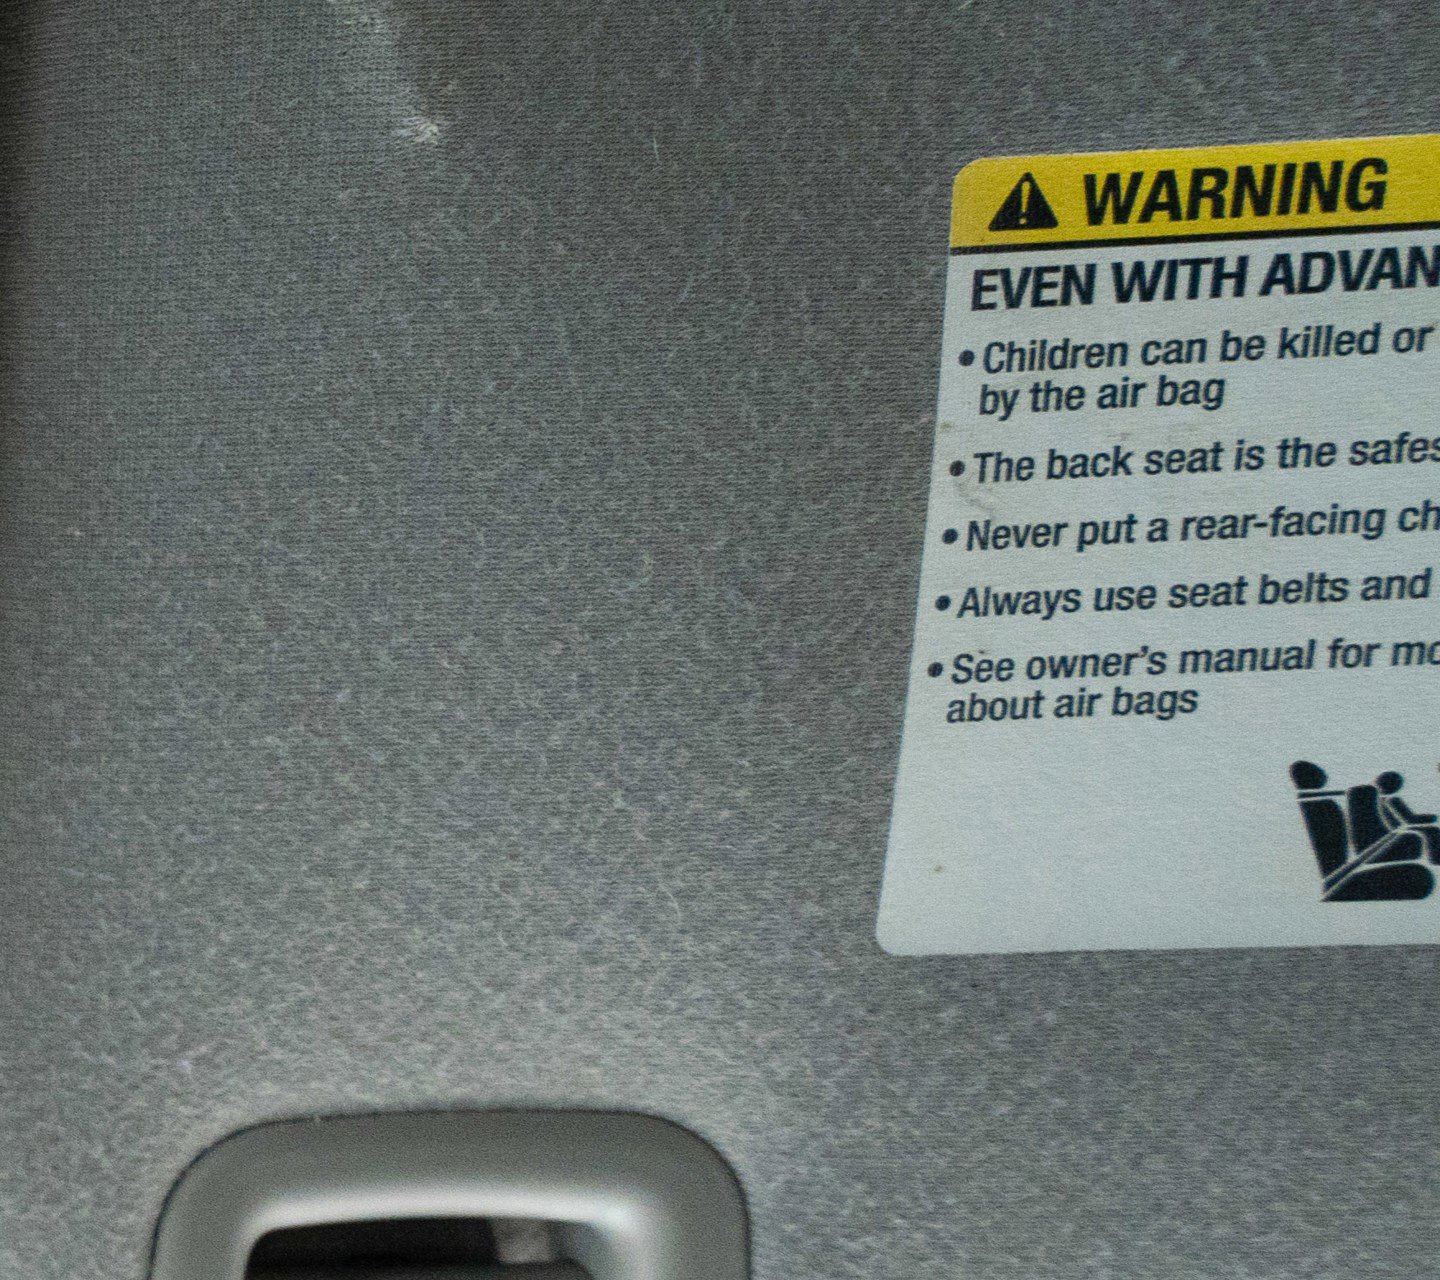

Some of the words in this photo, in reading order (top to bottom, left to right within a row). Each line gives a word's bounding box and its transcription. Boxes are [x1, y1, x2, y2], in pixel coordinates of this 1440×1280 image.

[1081, 158, 1389, 227] WARNING
[969, 262, 1098, 312] EVEN
[1110, 254, 1250, 303] WITH
[982, 338, 1129, 375] Children
[1140, 331, 1208, 365] can
[1219, 328, 1267, 363] be
[1277, 322, 1382, 360] killed
[1392, 325, 1433, 353] or
[979, 385, 1020, 423] by
[1029, 382, 1086, 412] the
[1097, 378, 1146, 408] air
[1157, 376, 1226, 411] bag
[973, 453, 1035, 484] The
[1046, 448, 1133, 481] back
[1145, 441, 1224, 475] seat
[1233, 440, 1266, 471] is
[1277, 438, 1338, 468] the
[966, 520, 1069, 553] Never
[1076, 516, 1137, 553] put
[1146, 521, 1170, 543] a
[1179, 504, 1389, 542] rear-facing
[956, 584, 1082, 621] Always
[1093, 583, 1158, 613] use
[1167, 577, 1247, 610] seat
[1258, 573, 1350, 605] belts
[1360, 568, 1432, 600] and
[951, 654, 1015, 684] See
[1026, 646, 1167, 681] owner's
[1178, 639, 1316, 674] manual
[1327, 638, 1380, 669] for
[946, 689, 1044, 723] about
[1053, 688, 1102, 718] air
[1112, 686, 1199, 720] bags
